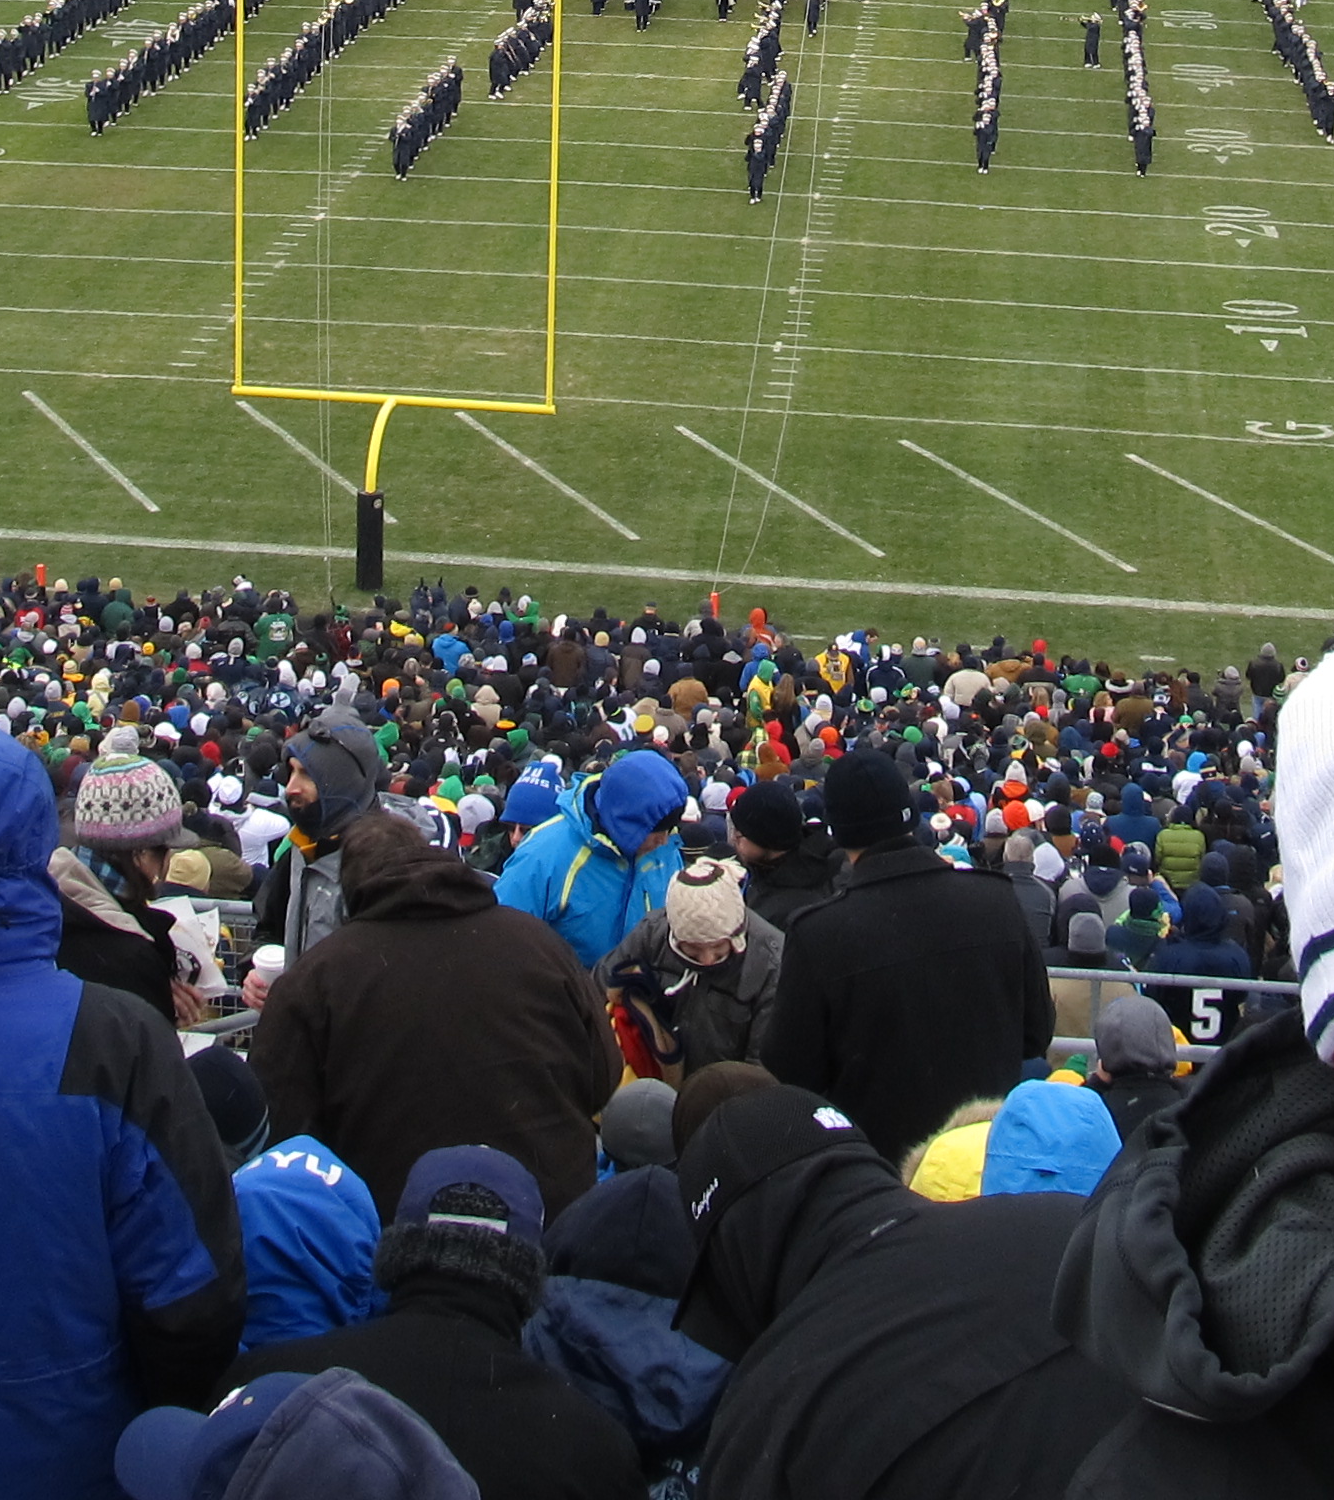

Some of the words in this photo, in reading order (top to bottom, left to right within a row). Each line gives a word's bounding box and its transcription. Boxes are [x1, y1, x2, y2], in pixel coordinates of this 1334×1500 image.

[1160, 10, 1218, 30] 50
[1171, 63, 1234, 88] 40
[1184, 128, 1254, 155] 30
[1202, 205, 1279, 239] 20
[1222, 299, 1309, 338] 10
[1190, 987, 1224, 1040] 5
